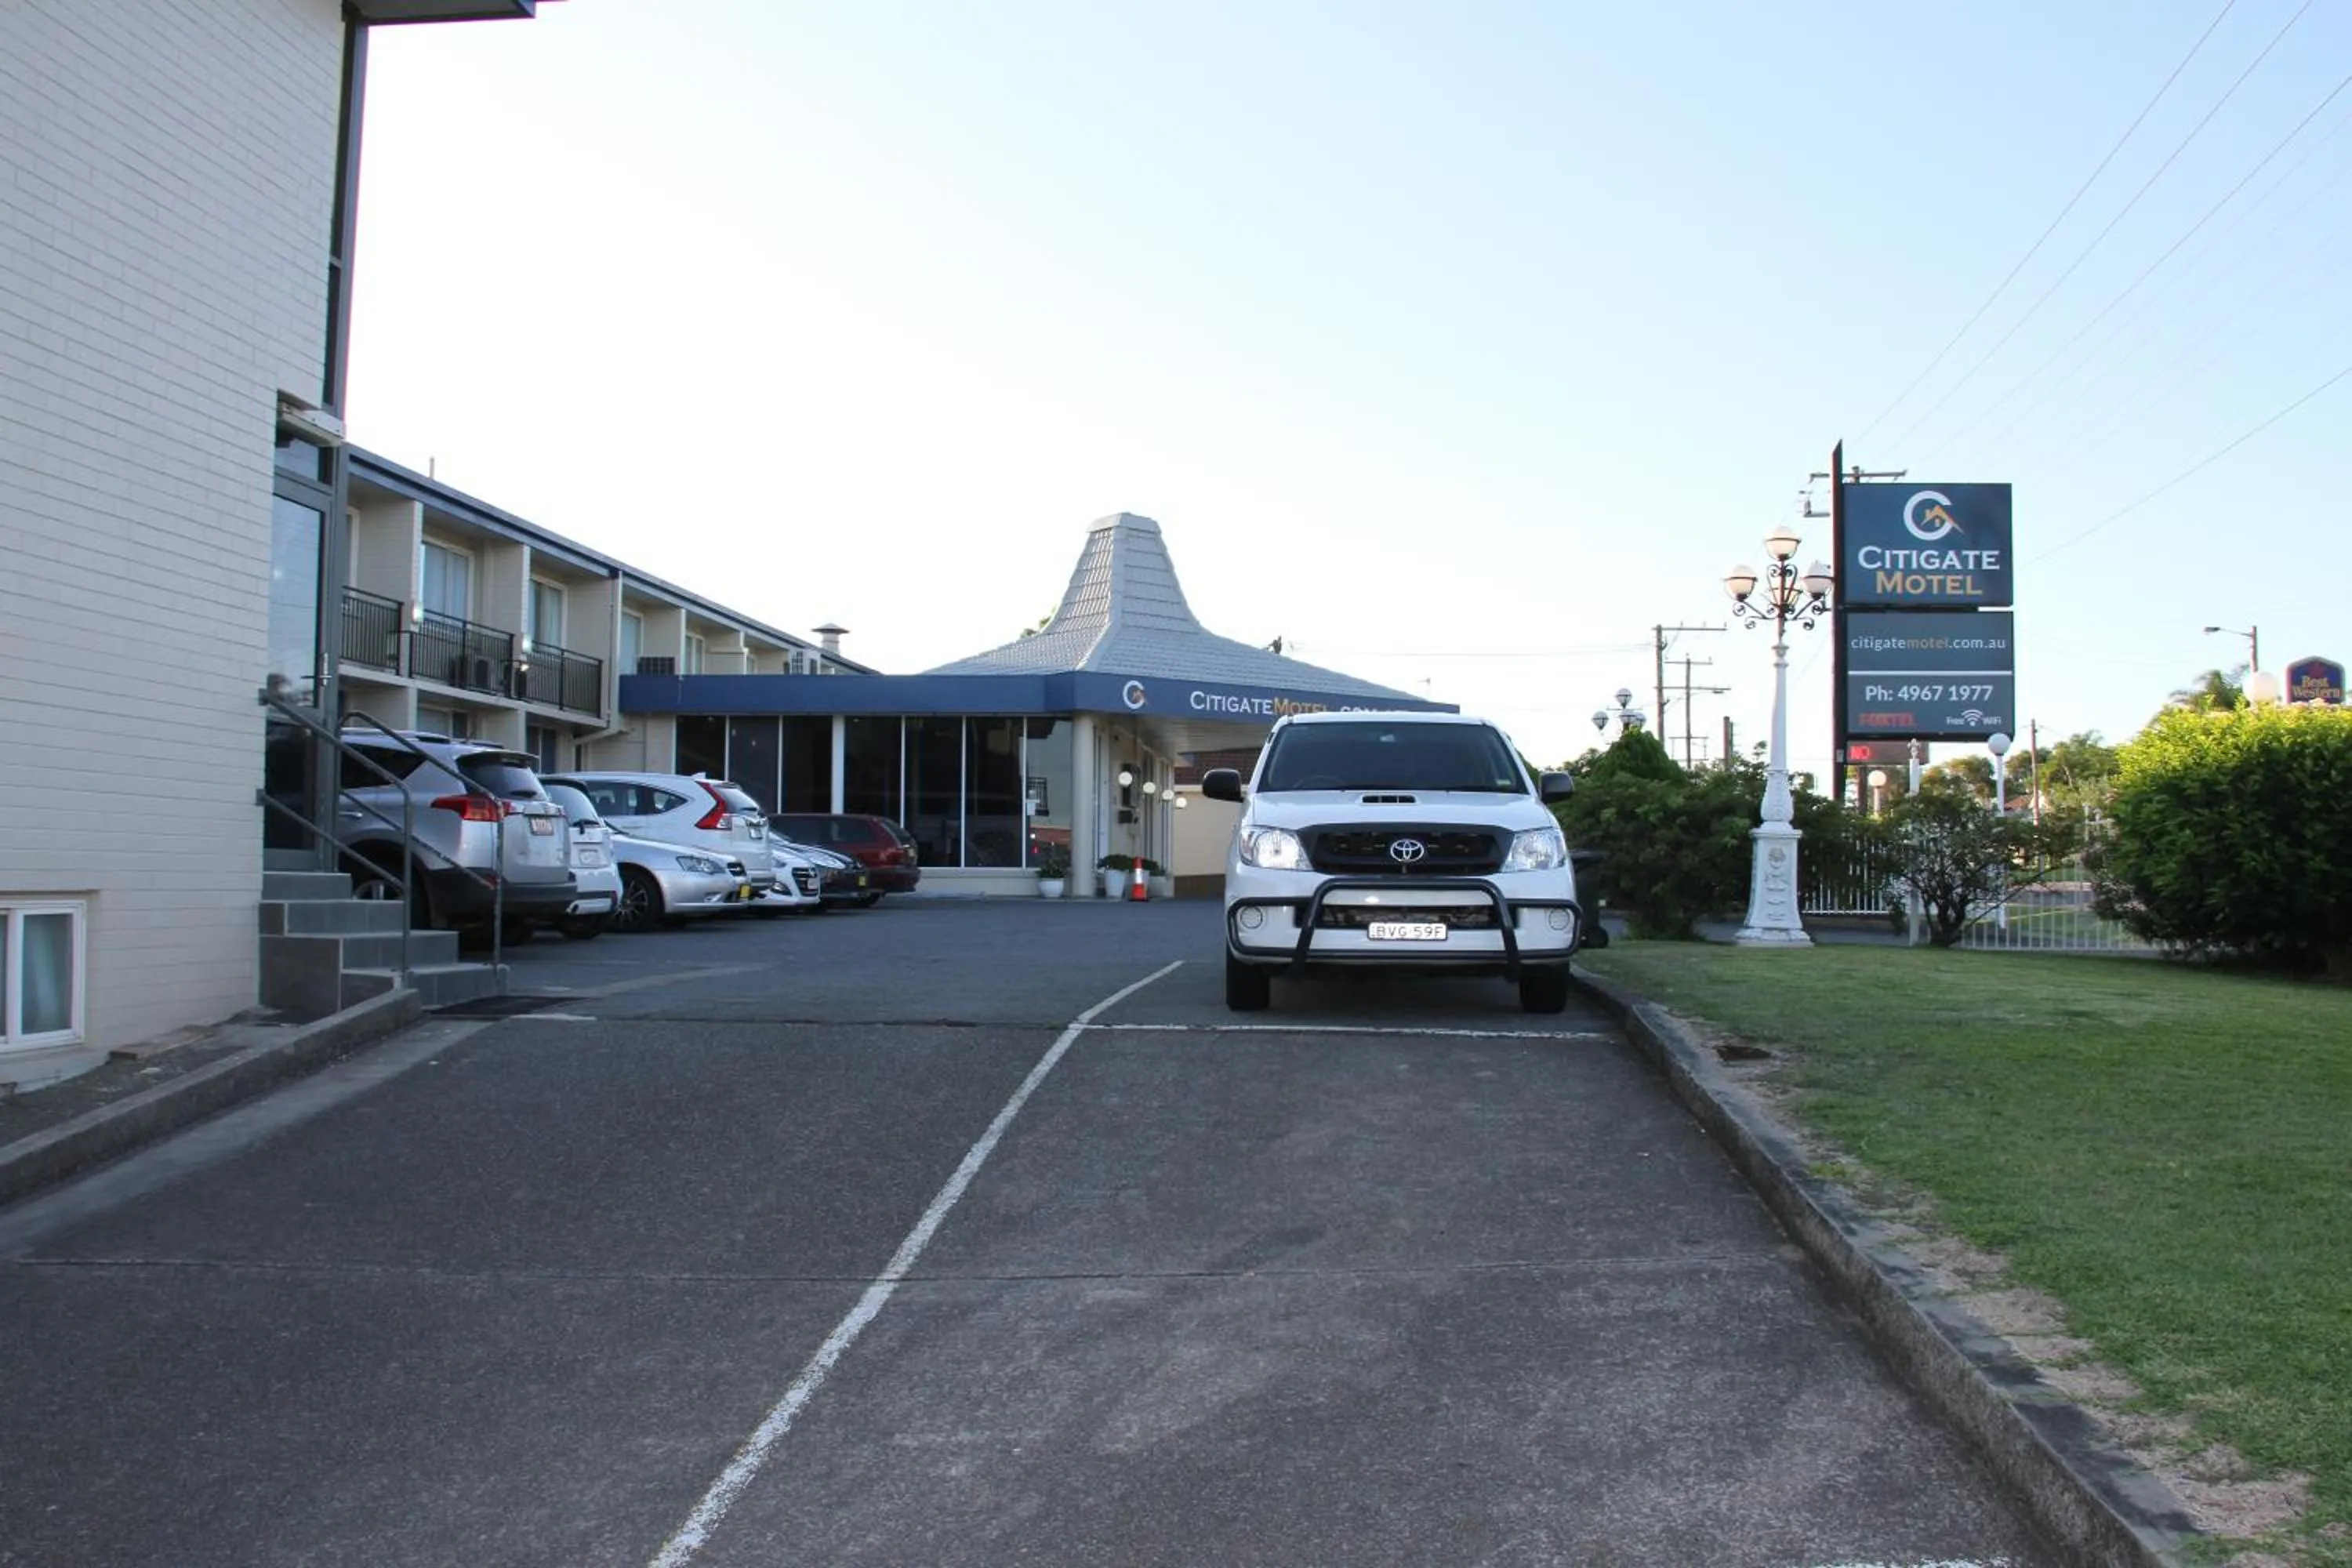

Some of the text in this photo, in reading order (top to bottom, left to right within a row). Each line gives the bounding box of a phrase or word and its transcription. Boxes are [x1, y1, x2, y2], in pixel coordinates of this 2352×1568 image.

[1857, 546, 2000, 570] CITIGATE
[1875, 570, 1983, 595] MOTEL
[1850, 636, 2006, 652] citigatemotel.com.au
[1865, 685, 1994, 701] Ph: 4967 1977
[1849, 746, 1871, 760] NO
